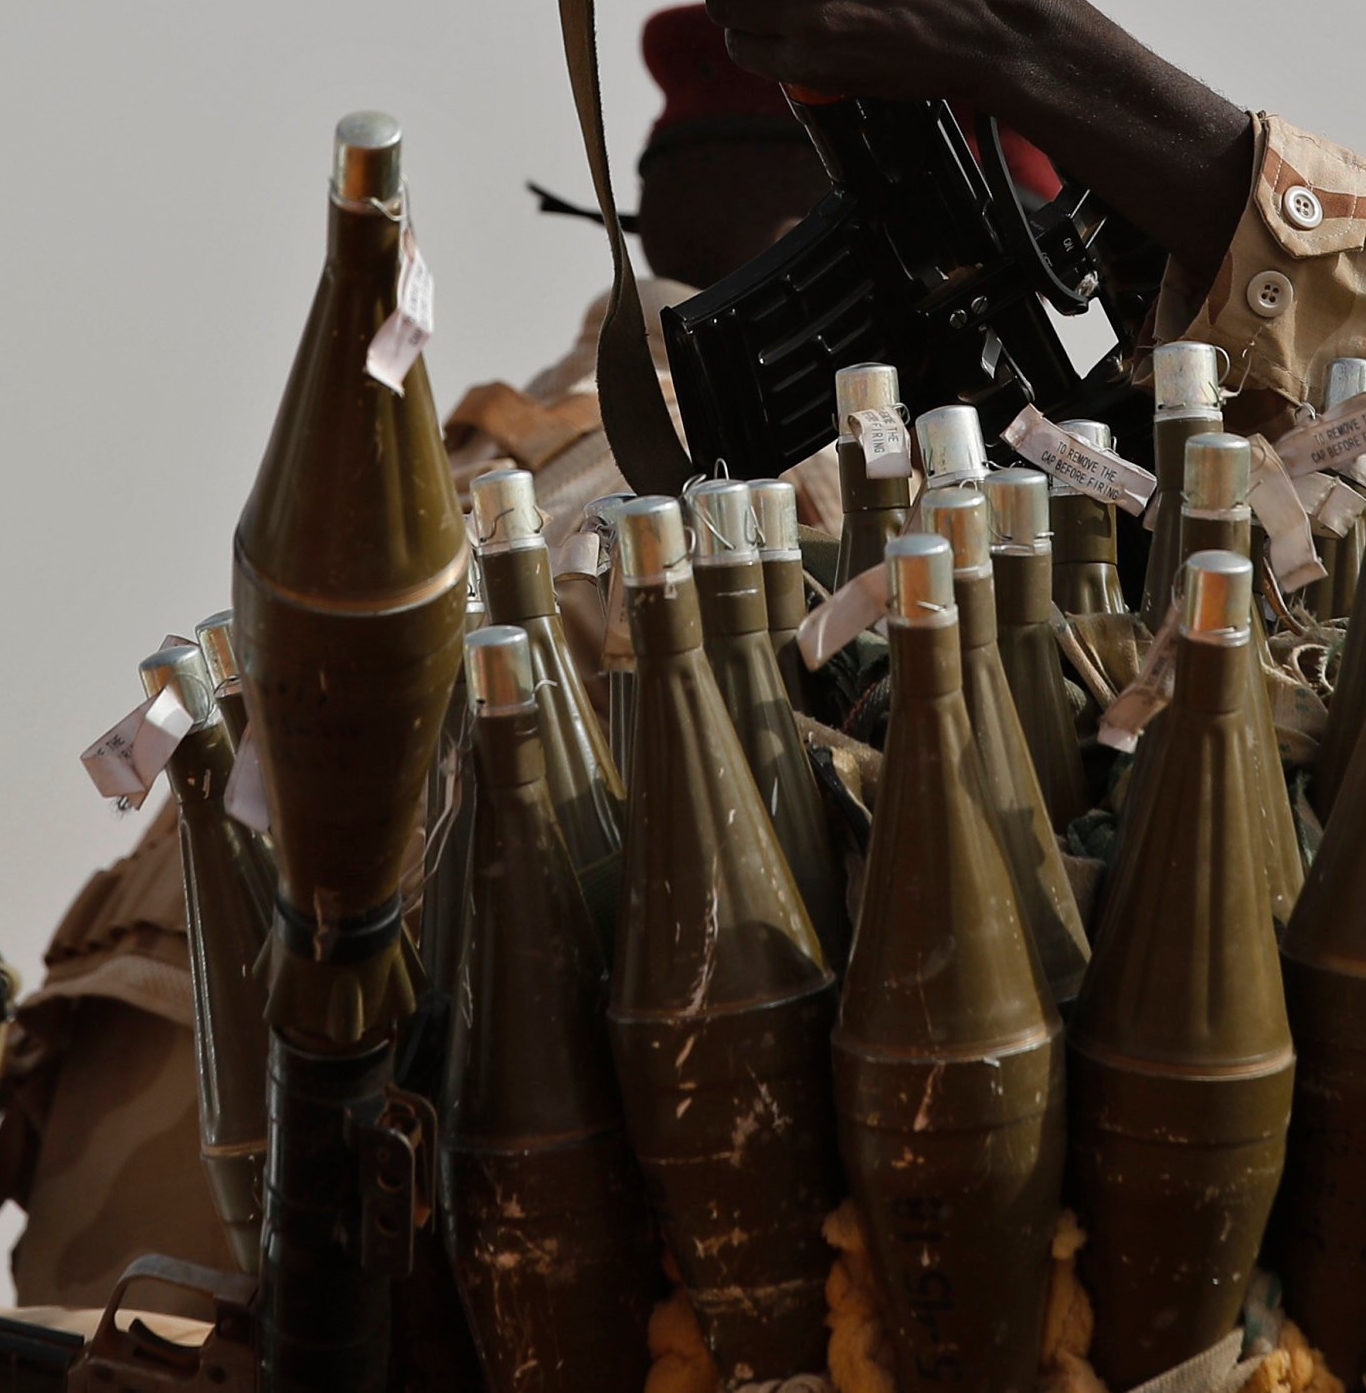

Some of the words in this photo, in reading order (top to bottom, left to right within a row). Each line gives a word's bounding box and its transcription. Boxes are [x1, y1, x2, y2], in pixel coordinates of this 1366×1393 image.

[871, 422, 885, 454] FIRING
[886, 427, 899, 443] THE
[1313, 434, 1325, 447] TO
[1326, 419, 1361, 441] REMOVE
[1057, 441, 1067, 456] TO
[1068, 447, 1099, 473] REMOVE
[1101, 464, 1118, 483] THE
[1310, 450, 1325, 464] CAP
[1328, 437, 1362, 458] BEFORE
[1041, 450, 1056, 466] CAP
[1055, 459, 1087, 485] BEFORE
[1087, 478, 1120, 501] FIRING
[105, 734, 125, 751] THE
